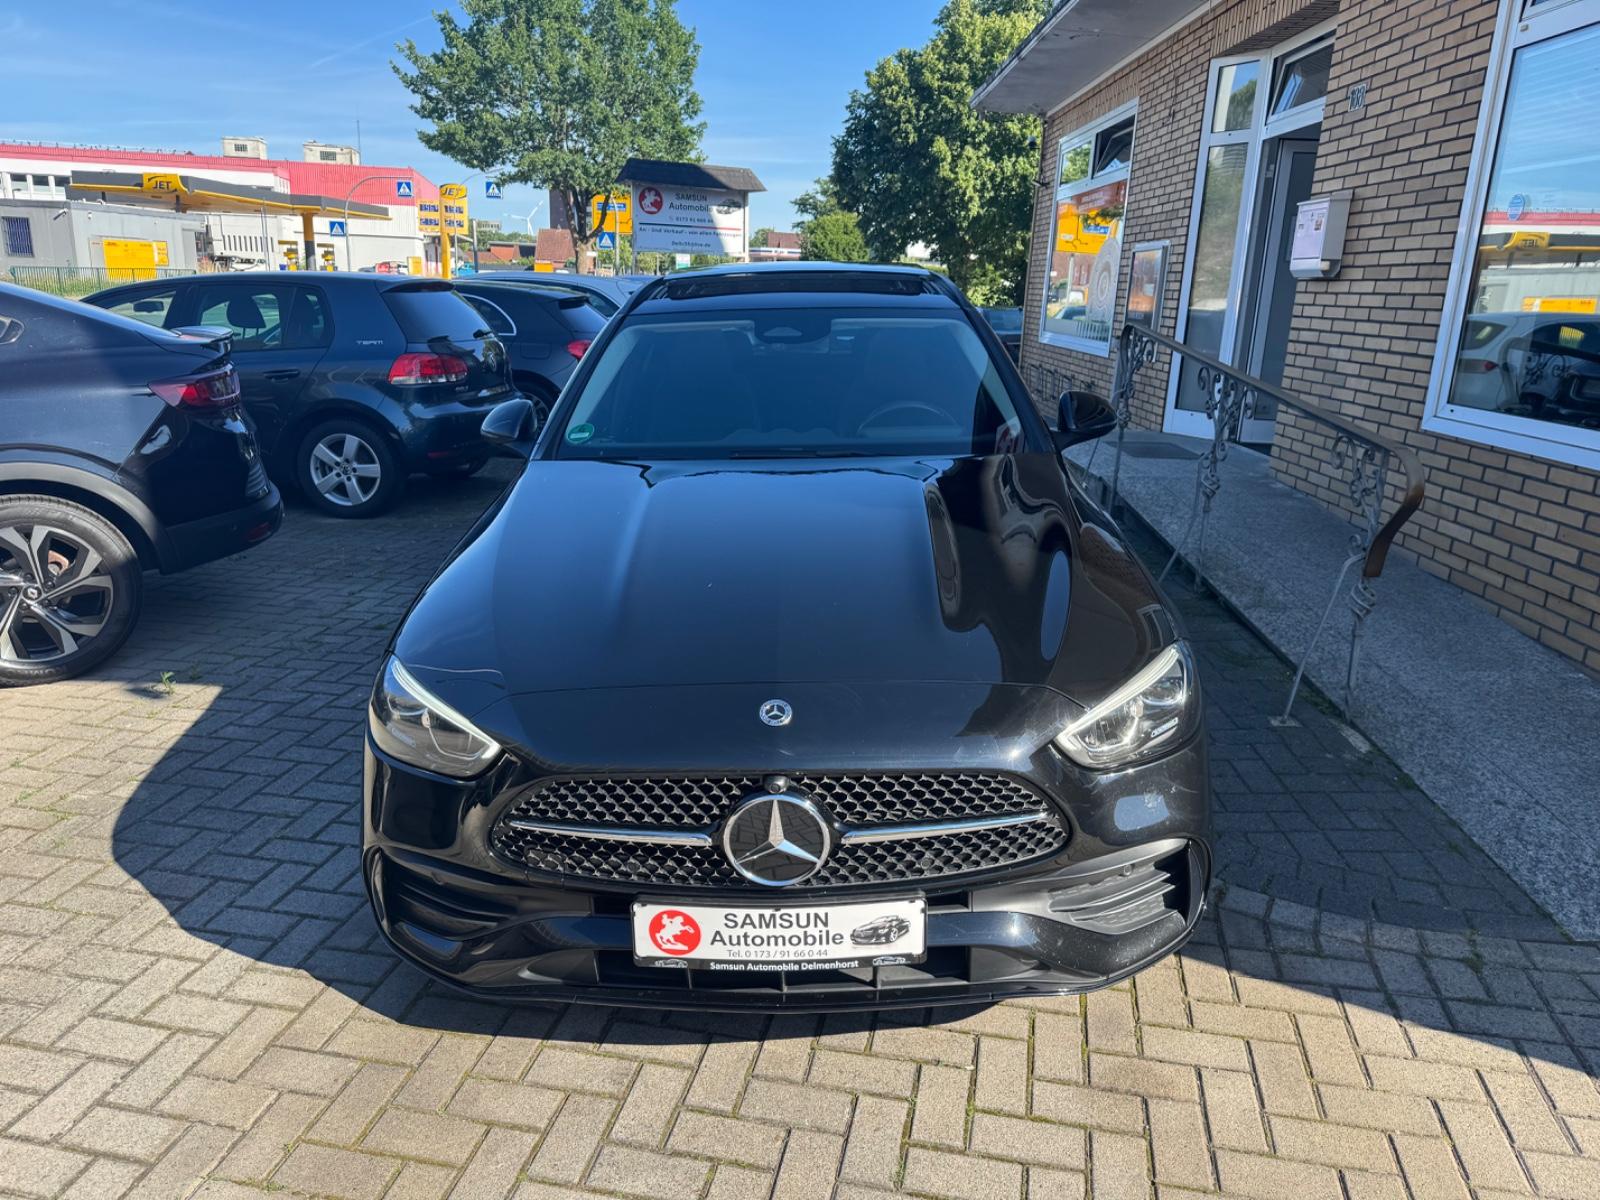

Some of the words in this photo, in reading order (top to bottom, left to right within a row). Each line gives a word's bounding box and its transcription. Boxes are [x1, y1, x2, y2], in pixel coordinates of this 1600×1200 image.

[152, 180, 172, 190] JET
[442, 187, 462, 197] JET
[675, 192, 707, 201] SAMSUN
[724, 912, 829, 929] SAMSUN
[710, 930, 844, 947] Automobile
[727, 949, 742, 958] Tel.
[710, 962, 745, 970] Samsun
[746, 963, 799, 971] Automobile
[801, 960, 859, 970] Delmenhorst
